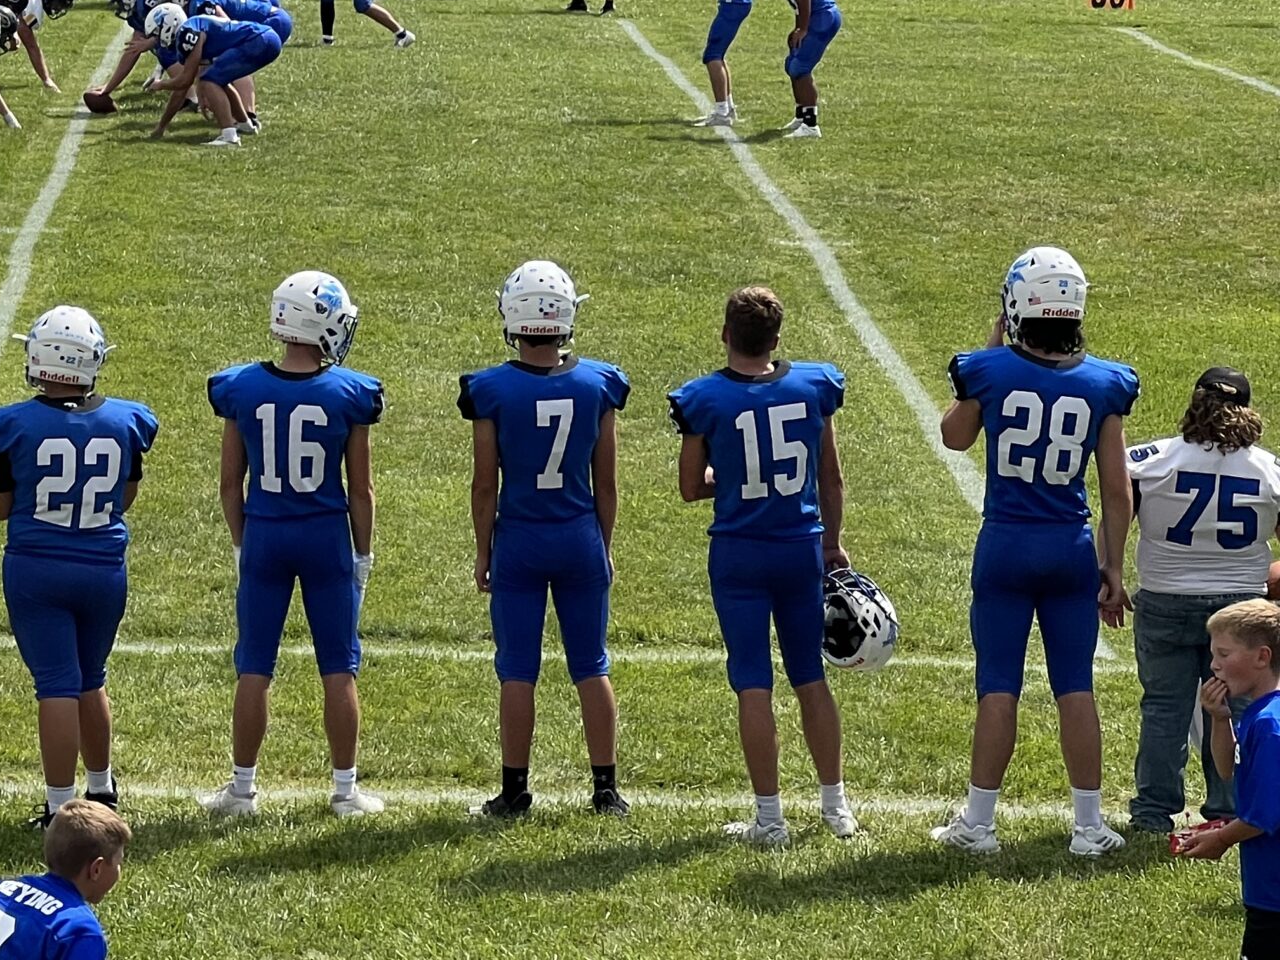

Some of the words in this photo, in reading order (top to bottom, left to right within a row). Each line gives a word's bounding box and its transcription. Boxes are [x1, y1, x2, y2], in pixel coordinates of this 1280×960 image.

[182, 32, 199, 52] 42
[520, 325, 560, 335] Riddell
[1042, 308, 1080, 319] Riddell
[39, 370, 80, 384] Riddell
[66, 356, 76, 364] 22
[255, 403, 328, 493] 16
[536, 398, 574, 490] 7
[735, 402, 808, 500] 15
[997, 390, 1091, 485] 28
[33, 437, 122, 529] 22
[1165, 470, 1261, 550] 75
